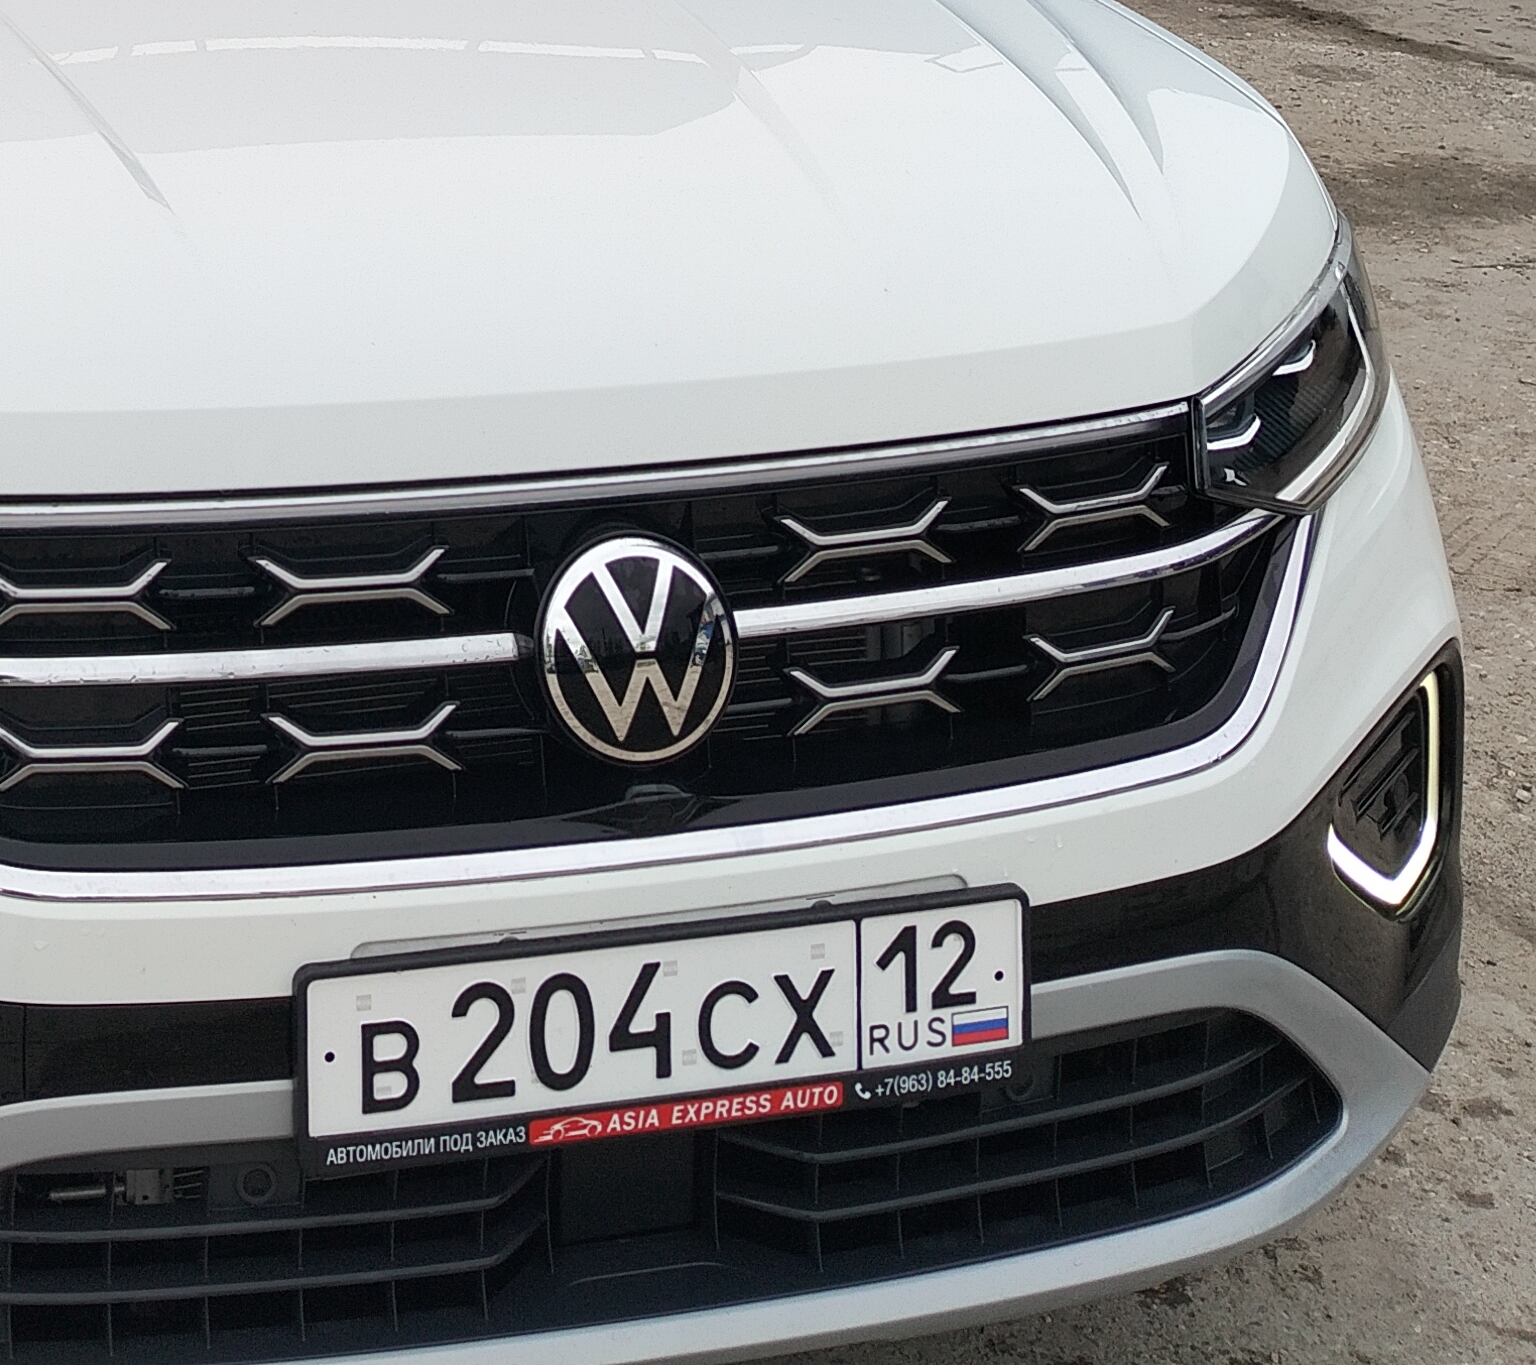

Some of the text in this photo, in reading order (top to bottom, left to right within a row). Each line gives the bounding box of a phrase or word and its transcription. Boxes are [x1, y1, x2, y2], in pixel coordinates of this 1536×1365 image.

[361, 919, 977, 1115] В204СХ 12
[868, 1016, 947, 1057] RUS
[874, 1060, 1013, 1099] +7(963) 84-84-555
[606, 1085, 839, 1134] ASIA EXPRESS AUTO
[325, 1125, 527, 1166] АВТОМОБИЛИ ПОД ЗАКАЗ
